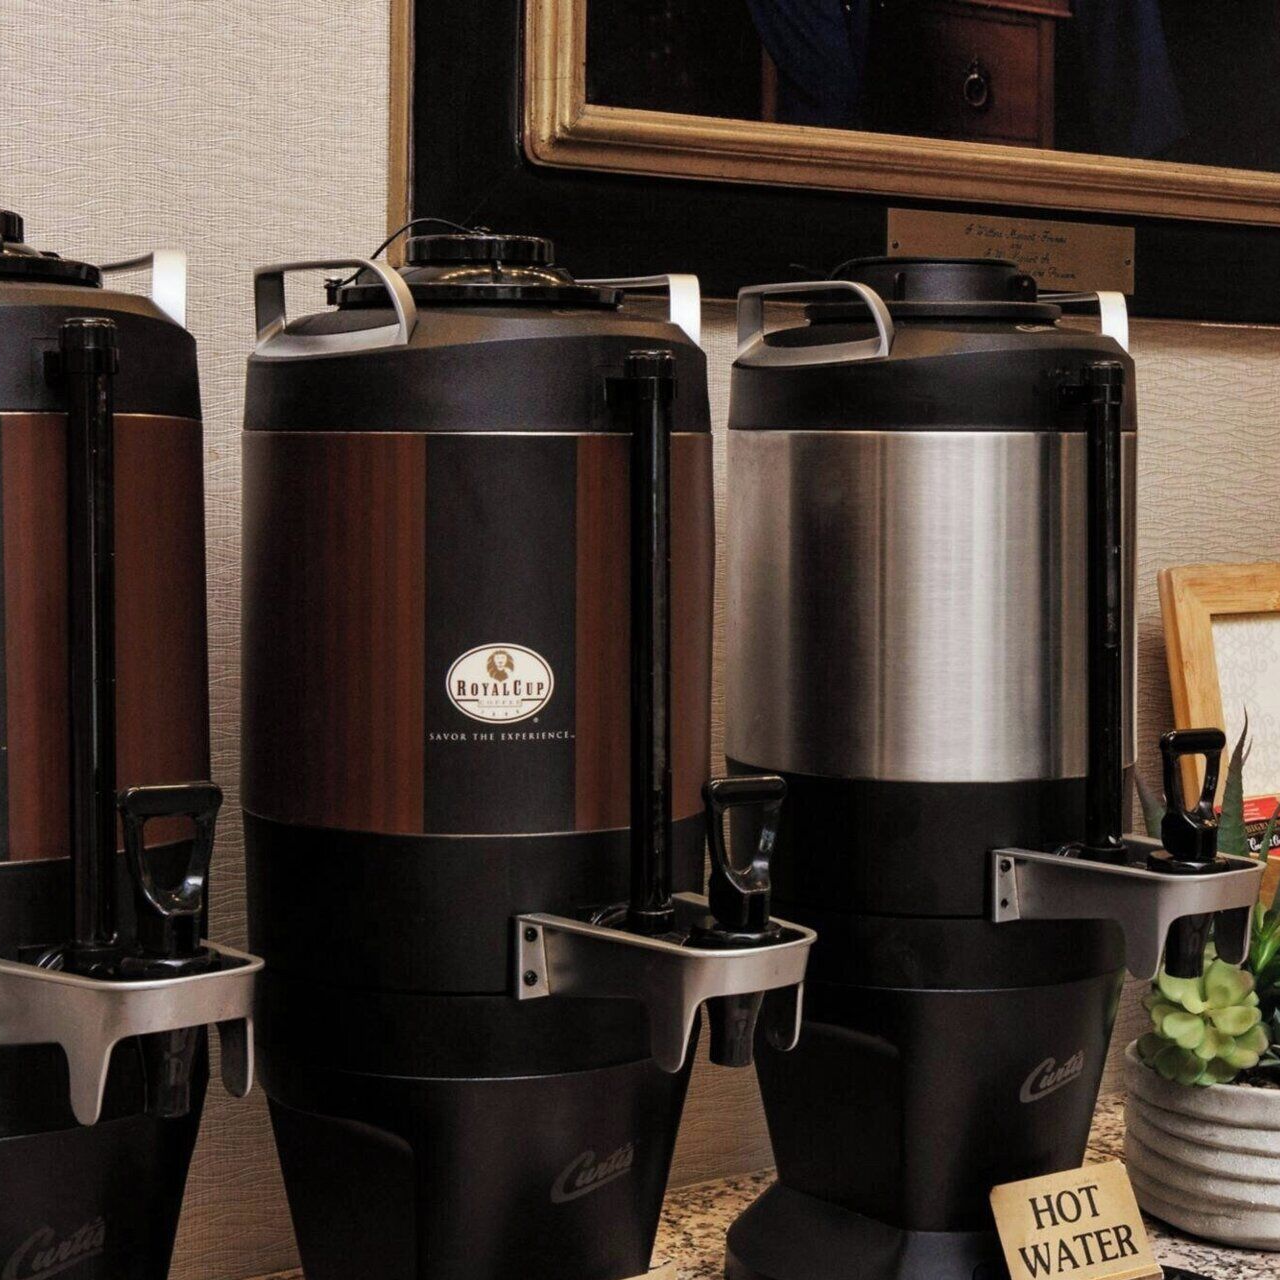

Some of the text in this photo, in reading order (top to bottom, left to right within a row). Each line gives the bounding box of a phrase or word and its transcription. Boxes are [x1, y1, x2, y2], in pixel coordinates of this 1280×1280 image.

[429, 731, 569, 741] SAVOR THE EXPERIENCE
[1028, 1184, 1100, 1230] HOT
[1018, 1223, 1139, 1279] WATER
